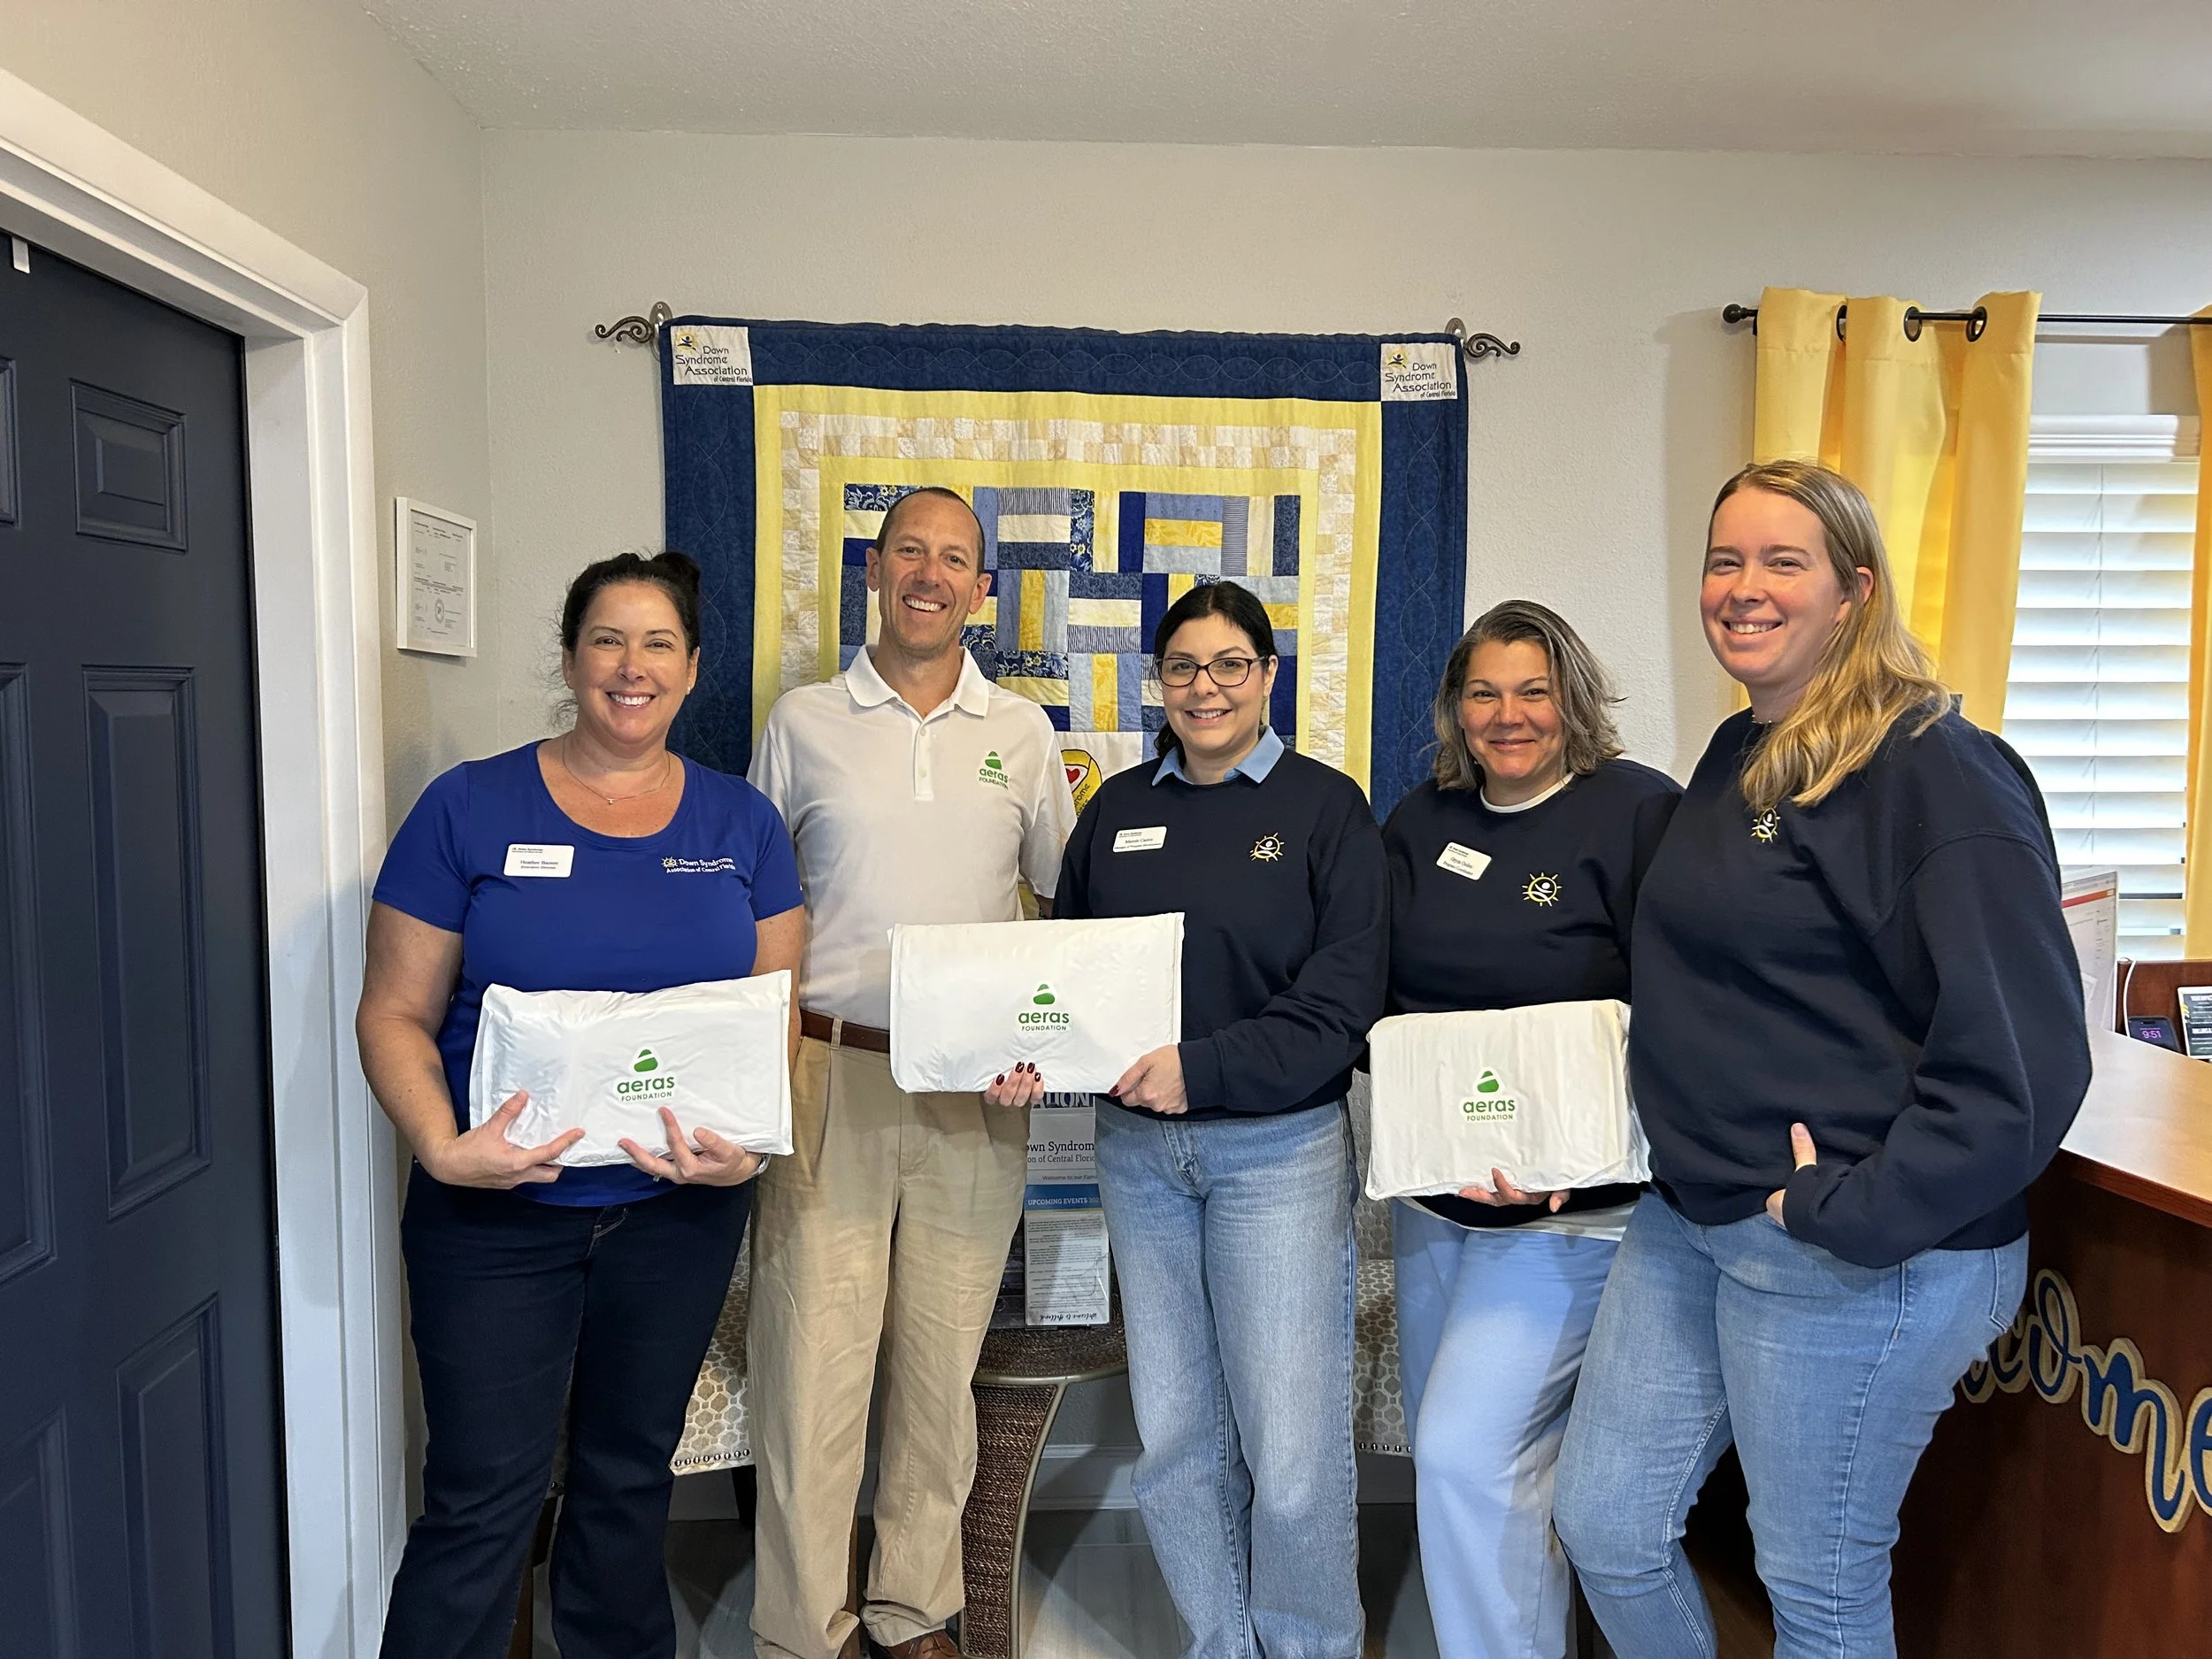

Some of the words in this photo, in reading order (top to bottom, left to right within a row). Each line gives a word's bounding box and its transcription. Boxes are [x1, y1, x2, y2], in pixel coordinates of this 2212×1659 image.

[675, 355, 727, 366] Syndrome
[685, 365, 748, 376] Association
[1385, 373, 1435, 384] Syndrome
[1393, 381, 1451, 392] Association
[979, 768, 1008, 783] aeras
[1074, 783, 1090, 806] rome
[699, 857, 733, 867] Syndrome
[1018, 1012, 1070, 1024] aeras
[2142, 1030, 2162, 1039] 9:51
[617, 1077, 675, 1094] aeras
[621, 1091, 672, 1102] FOUNDATION
[1463, 1099, 1516, 1113] aeras
[1048, 1141, 1094, 1155] Syndrom
[1048, 1154, 1073, 1163] Central
